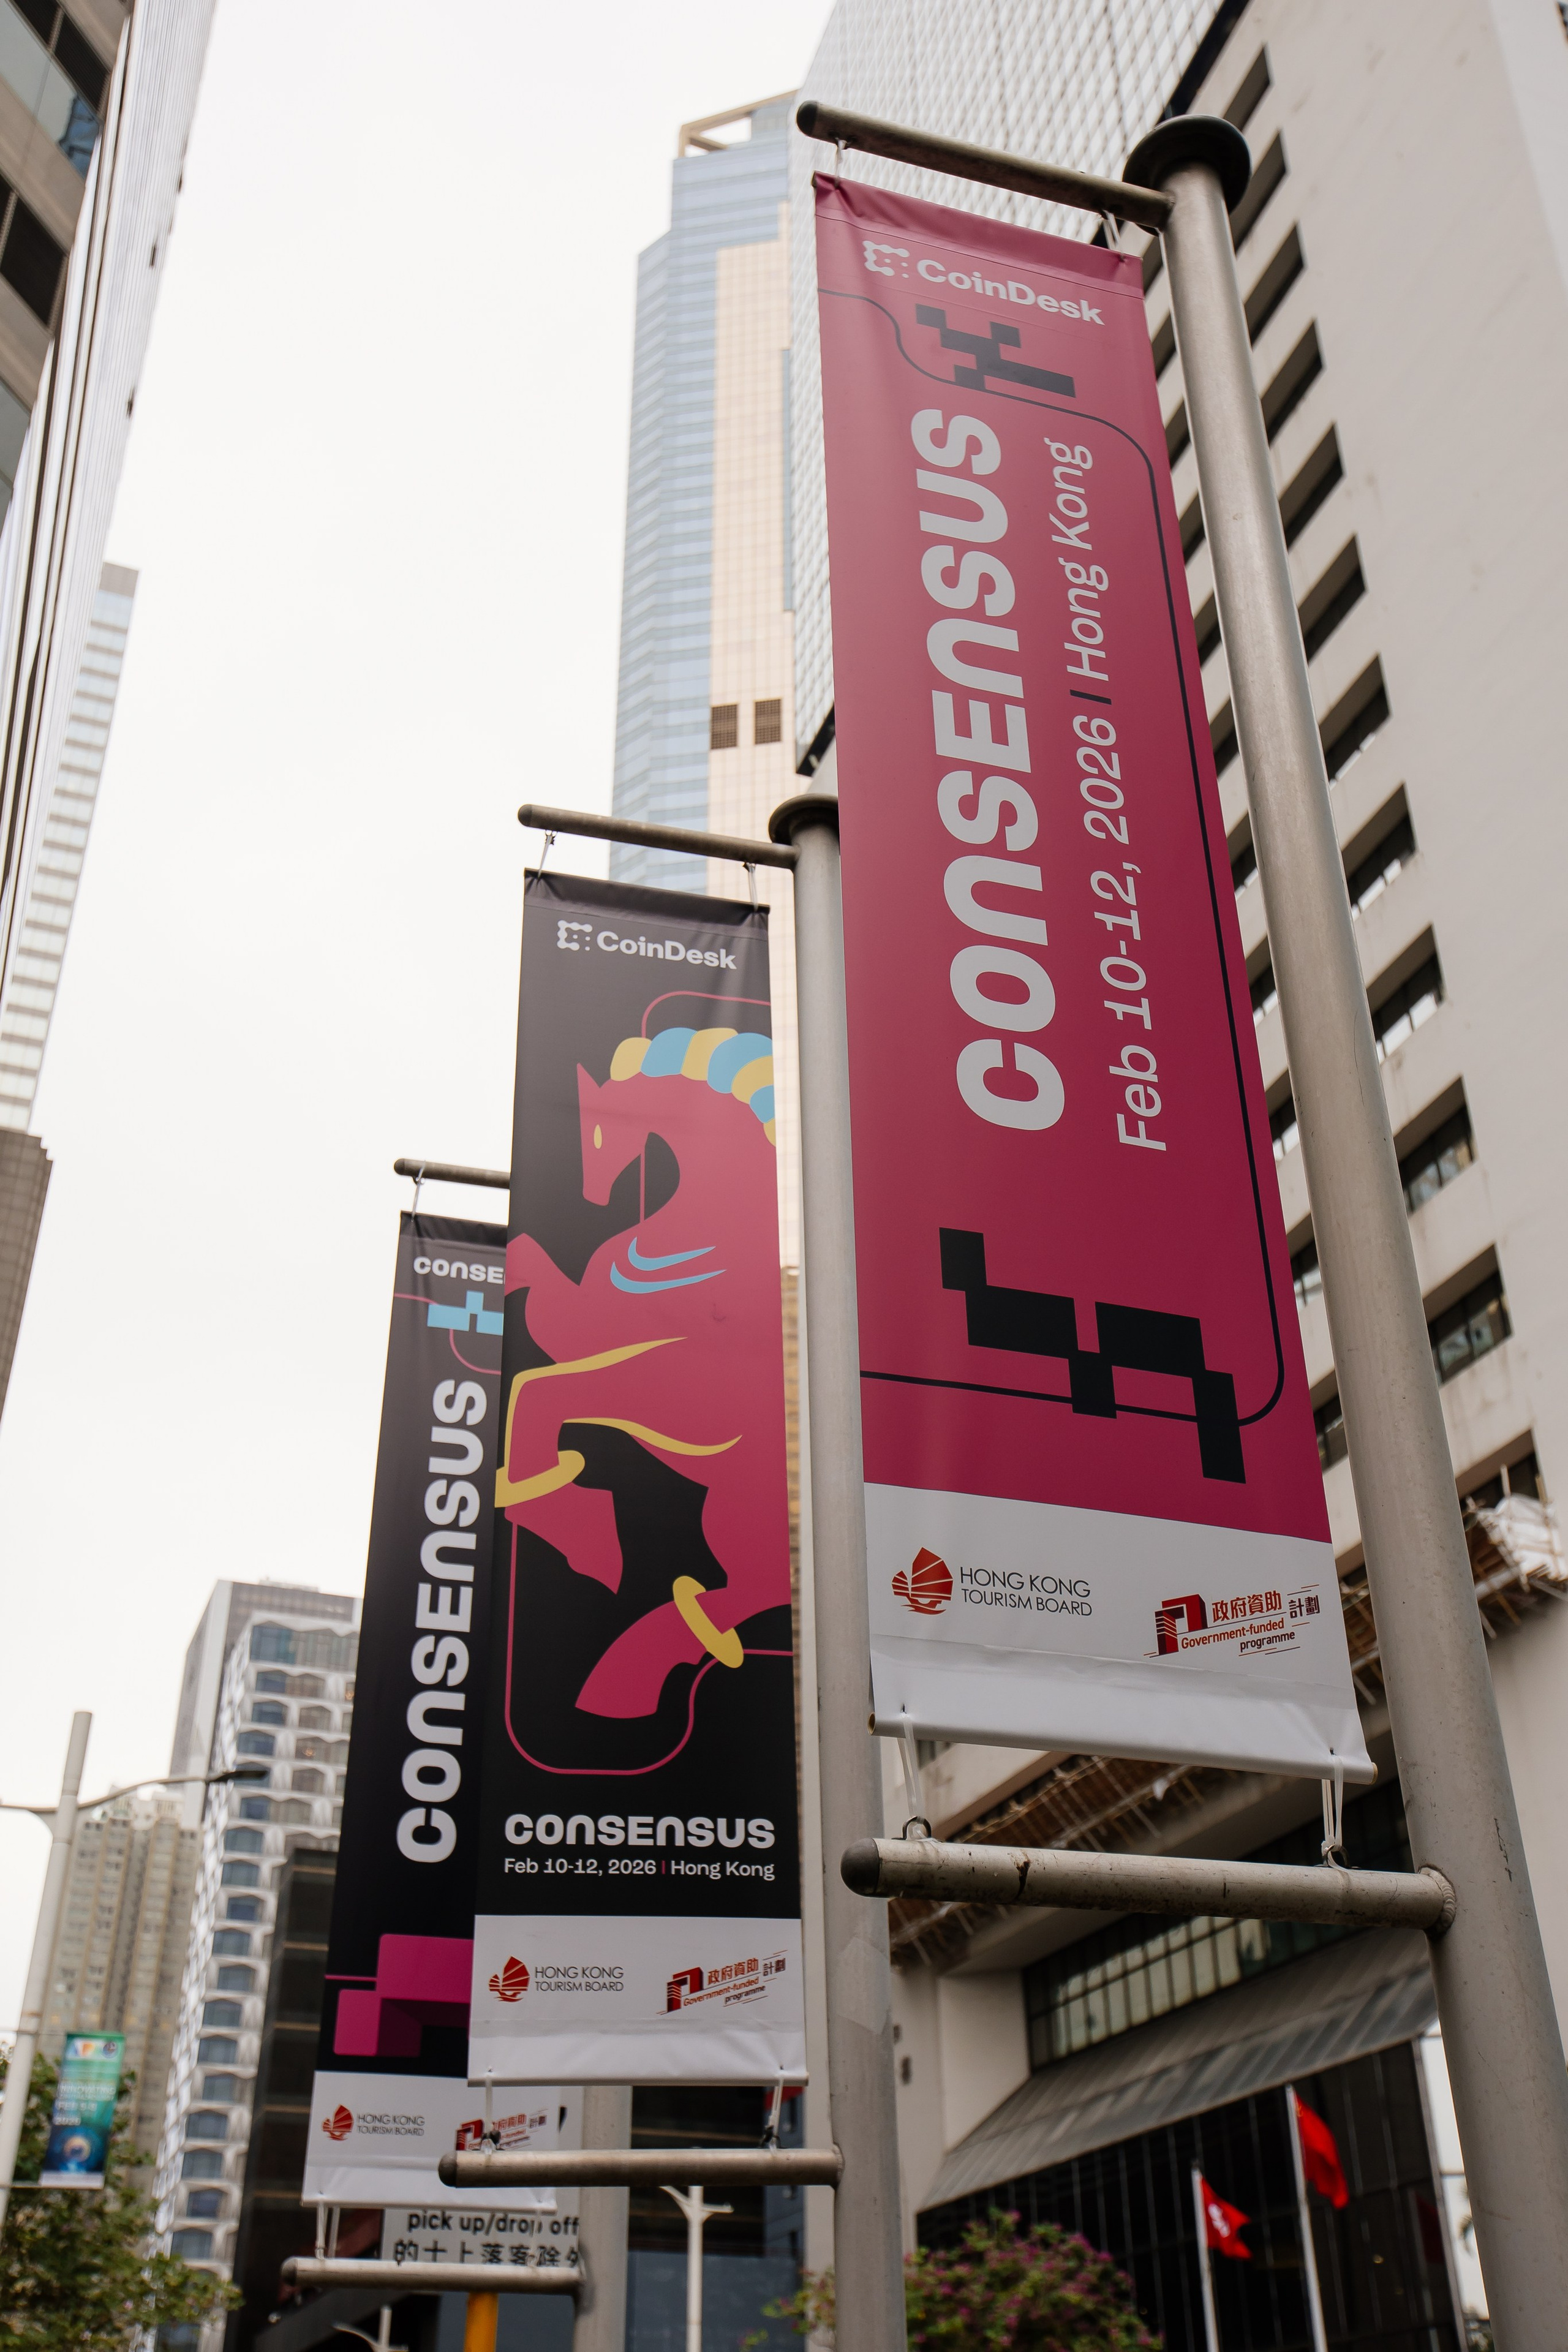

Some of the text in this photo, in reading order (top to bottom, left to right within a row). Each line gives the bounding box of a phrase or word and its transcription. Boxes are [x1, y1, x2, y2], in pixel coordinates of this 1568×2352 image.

[917, 258, 1104, 325] CoinDesk
[1042, 437, 1094, 551] Kong
[1057, 557, 1110, 682] Hong
[1072, 714, 1130, 845] 2026
[596, 930, 737, 970] CoinDesk
[1090, 862, 1153, 1031] 10-12,
[1108, 1044, 1167, 1152] Feb
[413, 1256, 505, 1285] CONSE
[960, 1566, 1091, 1598] HONG KONG
[961, 1588, 1092, 1617] TOURISM BOARD
[1212, 1590, 1321, 1623] 政府資助 計劃
[1181, 1617, 1284, 1649] Government-funded
[1240, 1631, 1295, 1653] programme
[505, 1858, 538, 1873] Feb
[543, 1858, 603, 1876] 10-12,
[608, 1859, 657, 1874] 2026
[671, 1860, 722, 1880] Hong
[726, 1861, 775, 1881] Kong
[535, 1966, 624, 1979] HONG KONG
[535, 1981, 624, 1992] TOURISM BOARD
[707, 1958, 759, 1986] 政府資助
[683, 1976, 760, 2007] Government-funded
[725, 1985, 766, 2004] programme
[357, 2113, 425, 2127] HONG KONG
[357, 2125, 424, 2136] TOURISM BOARD
[407, 2210, 579, 2236] pick up/drop off
